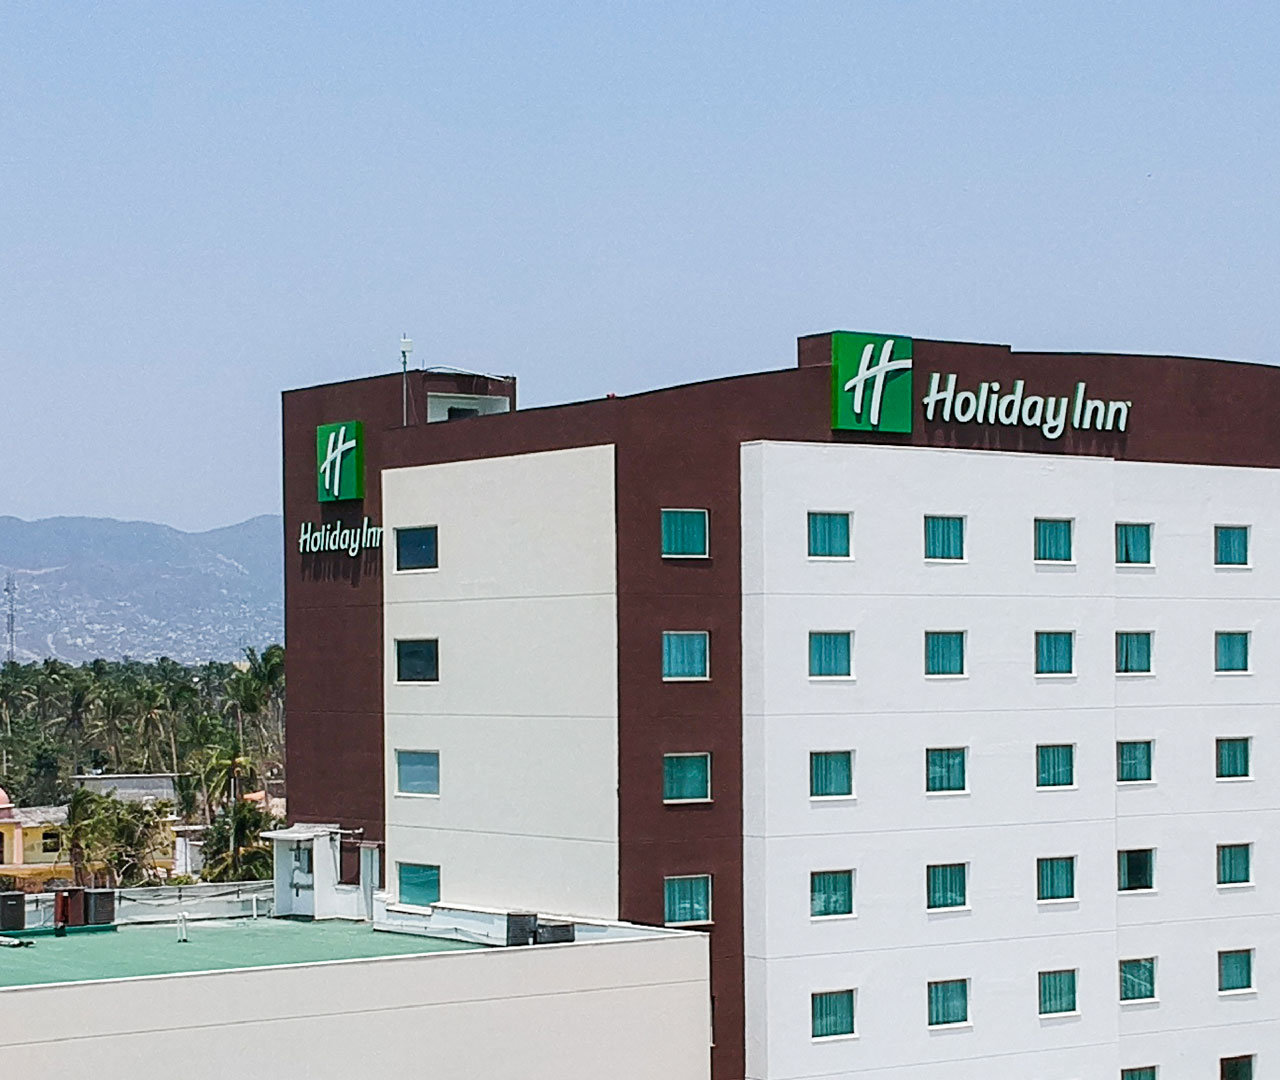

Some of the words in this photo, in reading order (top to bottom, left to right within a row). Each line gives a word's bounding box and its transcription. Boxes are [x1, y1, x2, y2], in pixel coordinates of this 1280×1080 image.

[843, 339, 913, 426] H
[921, 372, 1069, 440] Holiday
[1071, 381, 1131, 433] Inn
[320, 425, 357, 497] H
[298, 519, 361, 557] Holiday
